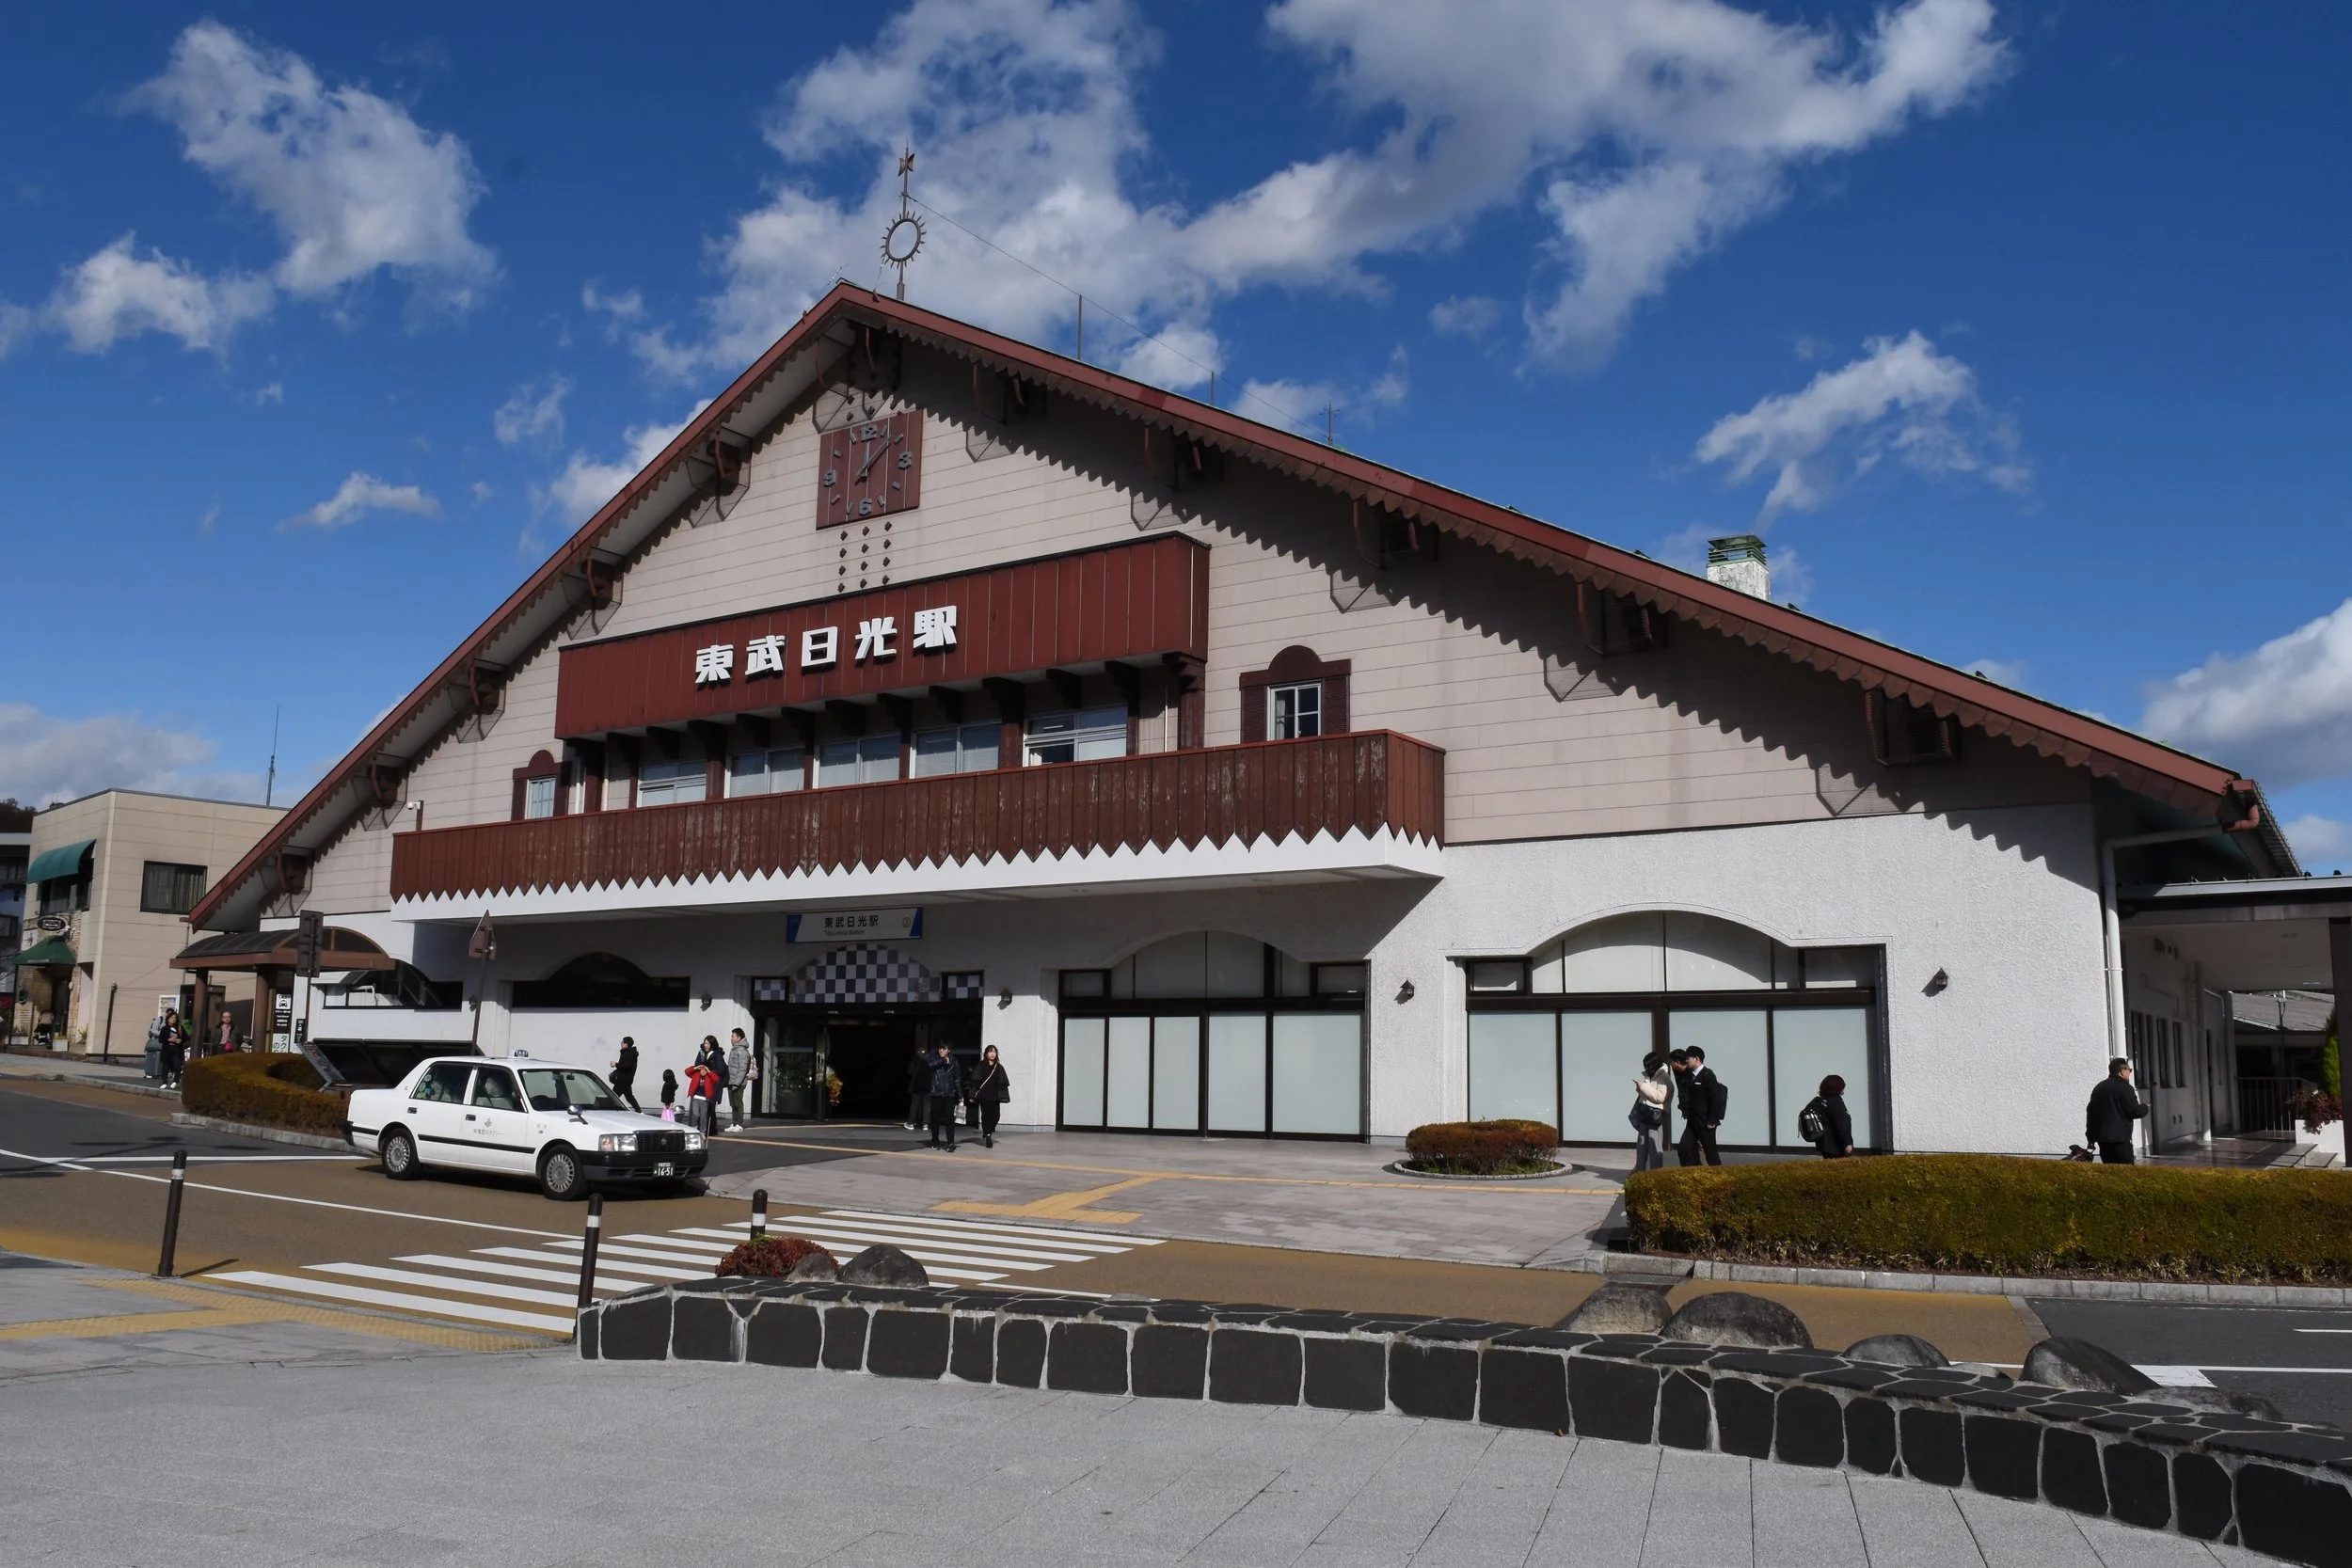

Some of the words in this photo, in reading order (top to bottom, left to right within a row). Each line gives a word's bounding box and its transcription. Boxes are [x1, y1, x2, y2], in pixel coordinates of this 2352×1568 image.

[861, 423, 877, 441] 12
[898, 451, 912, 469] 3
[823, 469, 836, 486] 9
[859, 498, 872, 515] 6
[695, 606, 958, 684] 東武日光駅
[824, 914, 879, 928] 東武日光駅
[658, 1166, 674, 1176] 16-51
